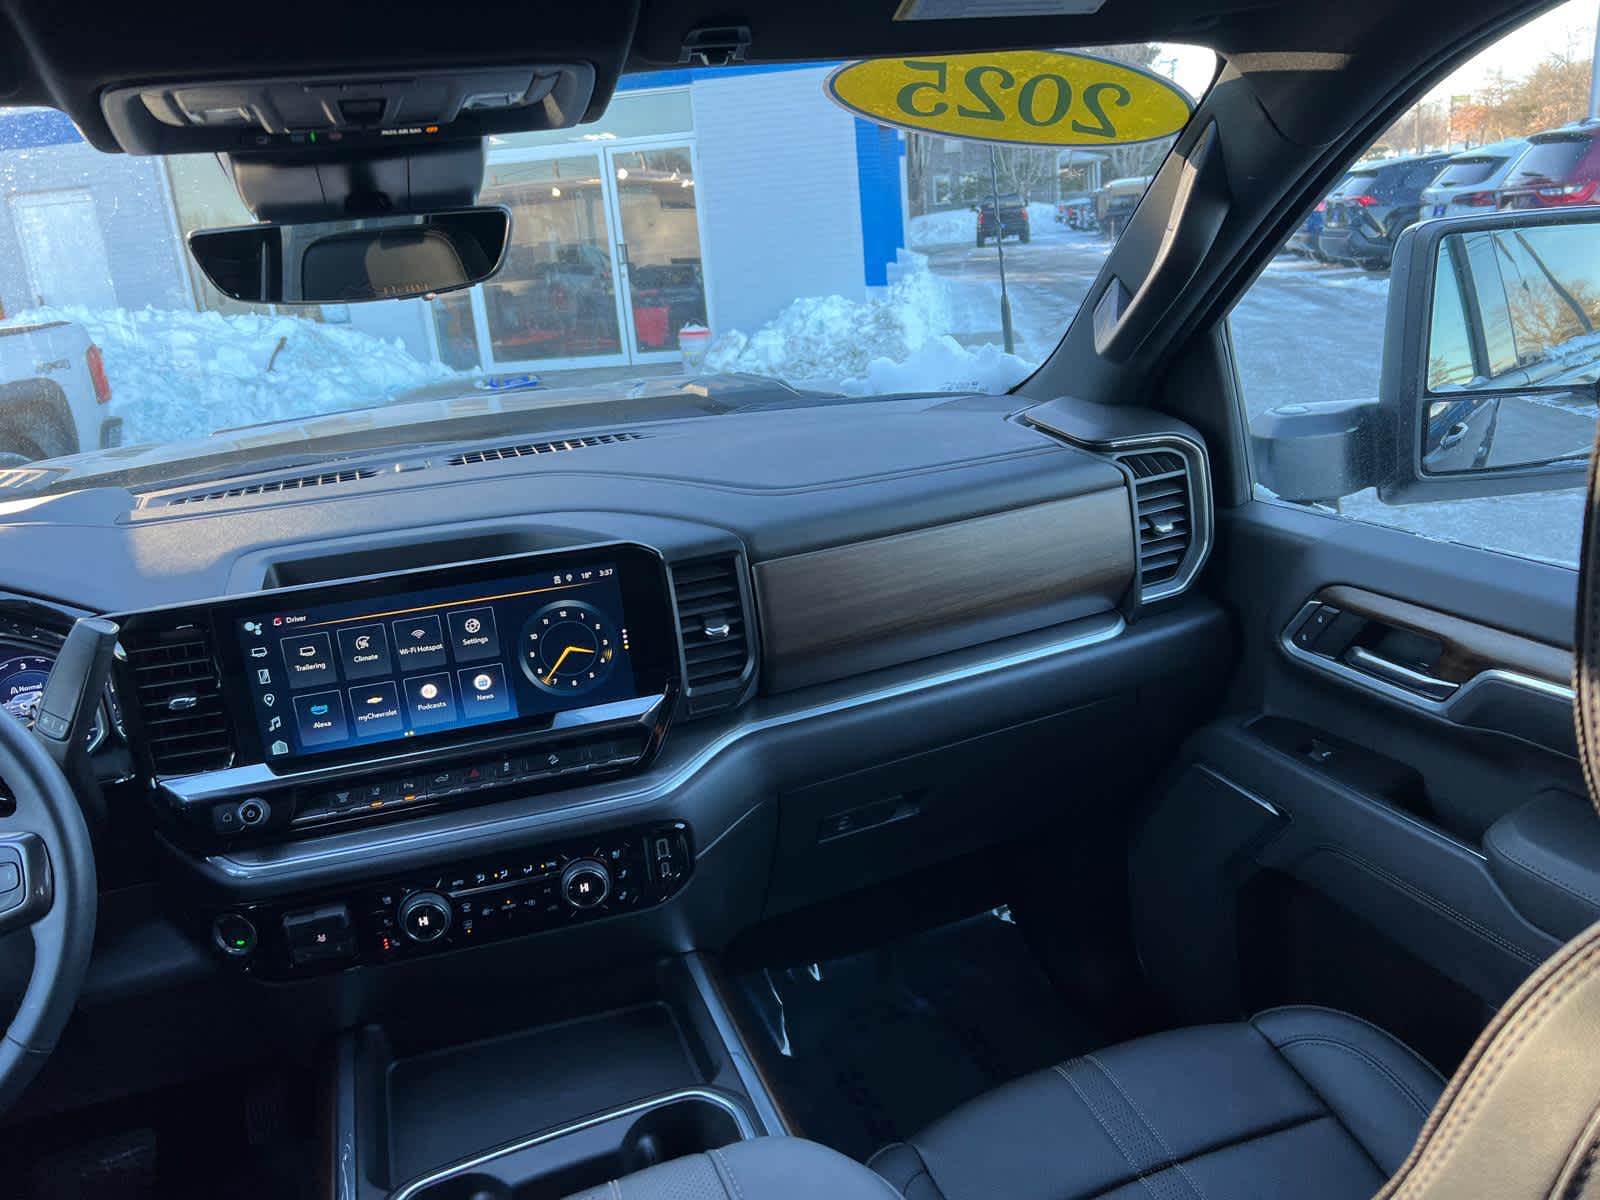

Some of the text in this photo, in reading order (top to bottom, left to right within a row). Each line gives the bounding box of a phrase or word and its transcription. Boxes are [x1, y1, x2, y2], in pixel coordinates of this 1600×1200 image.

[599, 568, 613, 577] 3:37
[286, 615, 307, 624] Driver
[462, 636, 489, 646] Settings
[400, 643, 443, 656] Wi-Fi Hotspot
[354, 653, 378, 663] Climate
[296, 662, 326, 673] Trailering
[476, 693, 494, 701] News
[417, 701, 447, 711] Podcasts
[358, 709, 398, 721] myChevrolet
[313, 721, 332, 729] Alexa
